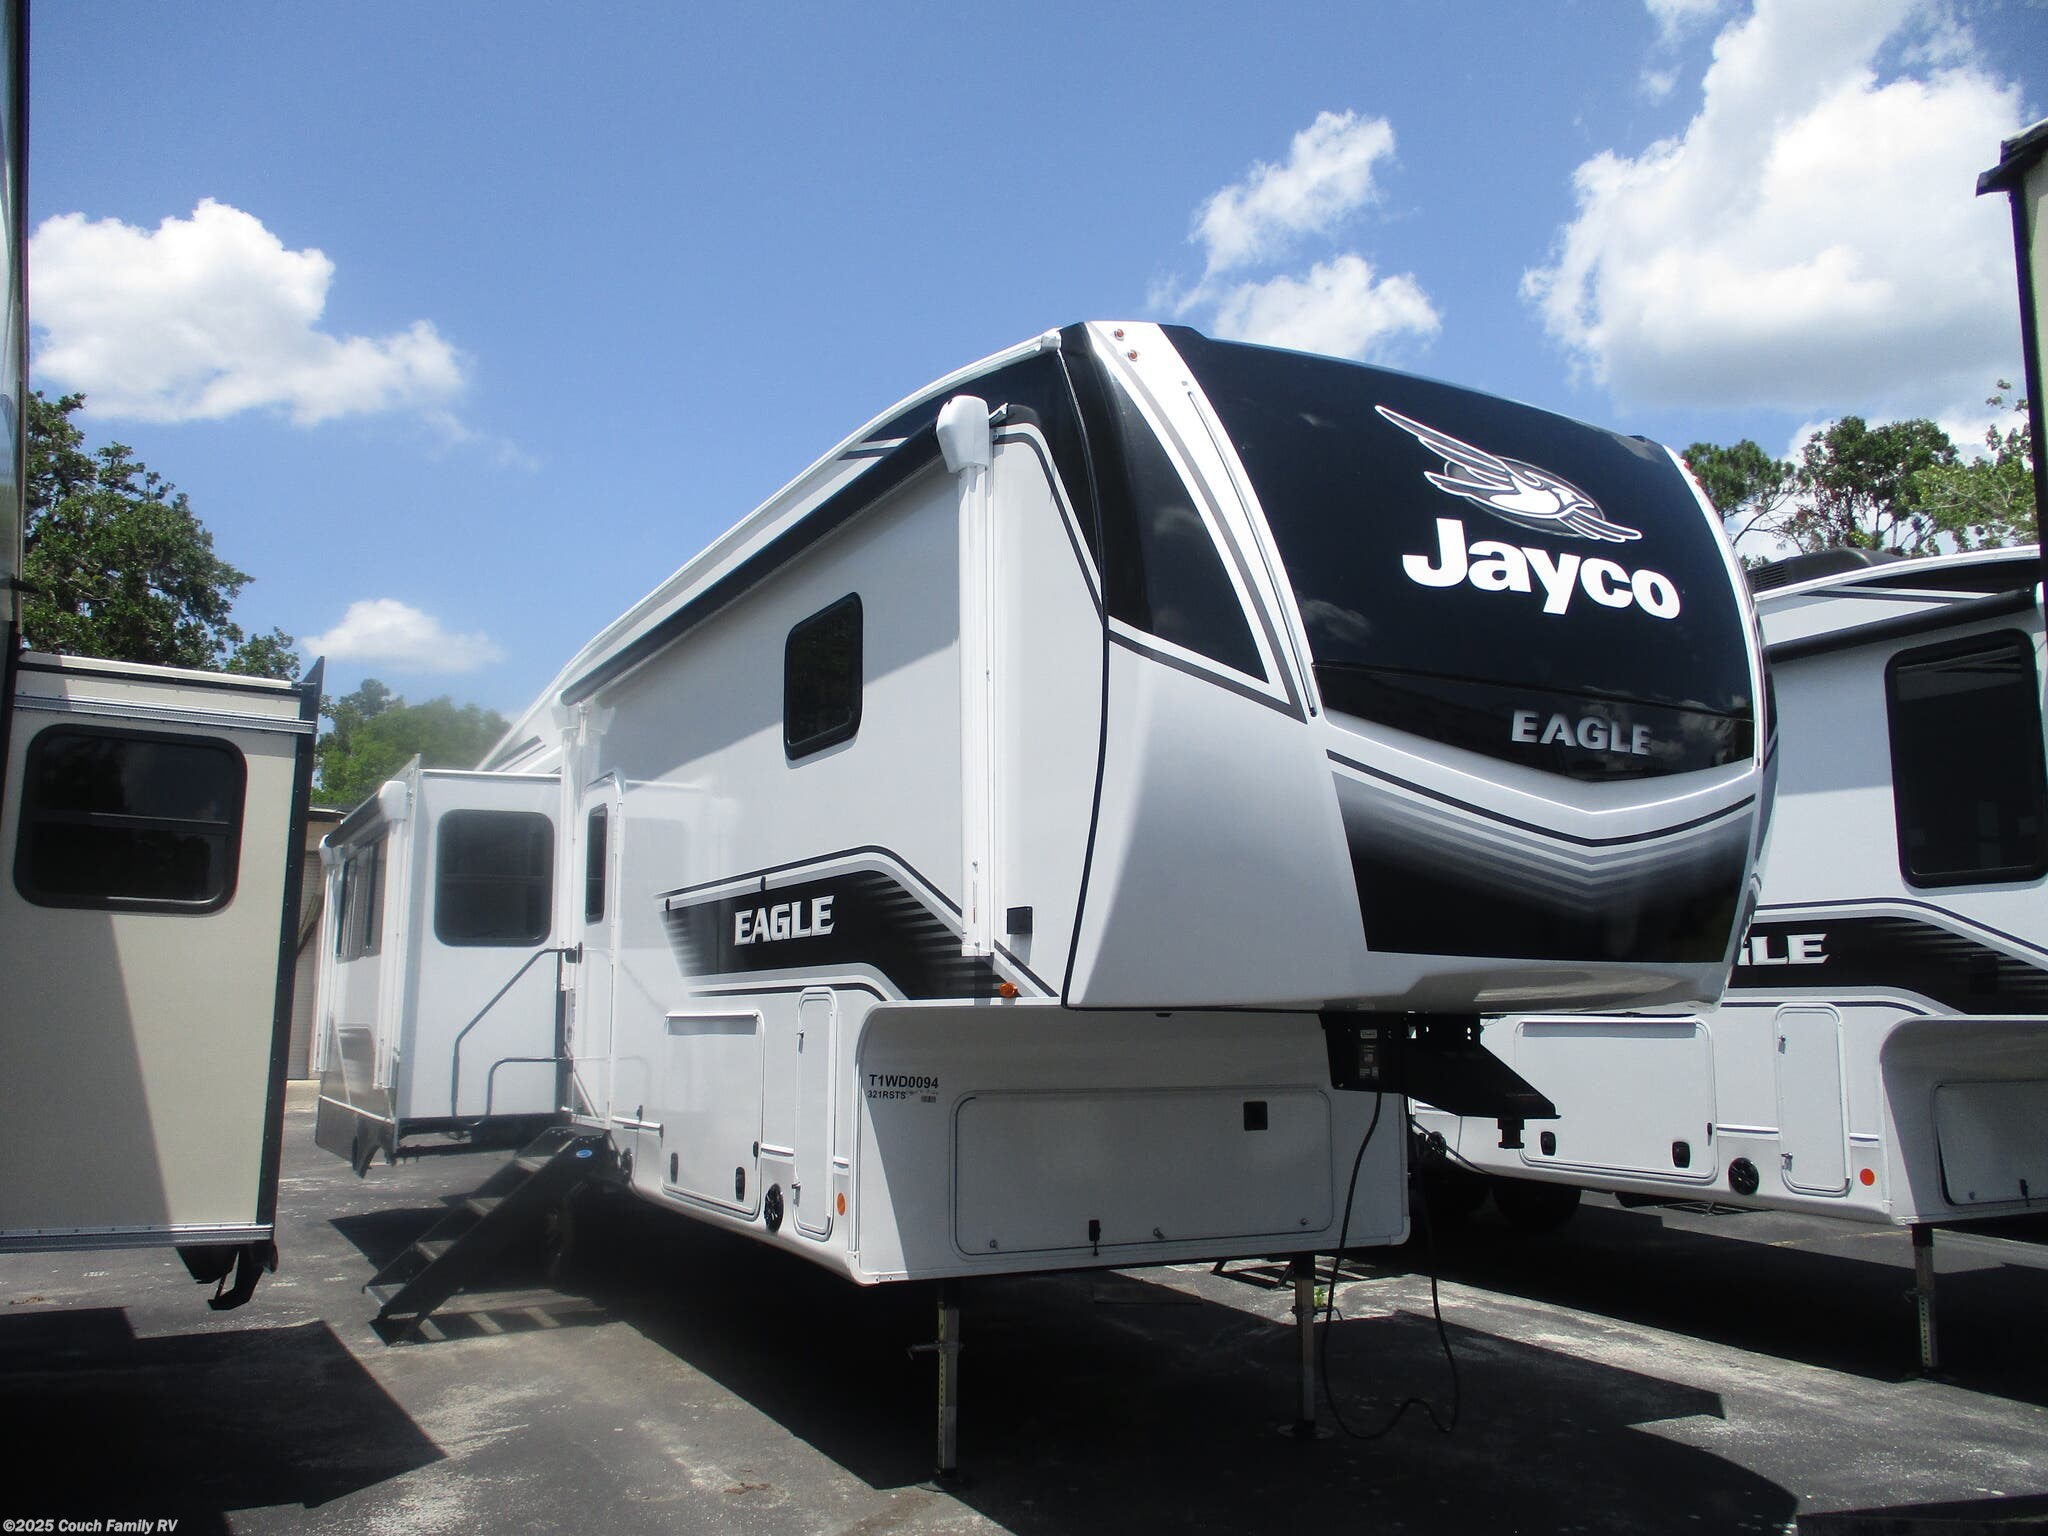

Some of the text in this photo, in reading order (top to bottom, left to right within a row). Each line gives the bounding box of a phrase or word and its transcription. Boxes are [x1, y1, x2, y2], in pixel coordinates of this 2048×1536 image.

[1402, 517, 1681, 620] Jayco
[1511, 709, 1652, 755] EAGLE
[734, 895, 836, 946] EAGLE
[867, 1090, 907, 1100] 321RSTS
[869, 1074, 939, 1089] T1WD0094
